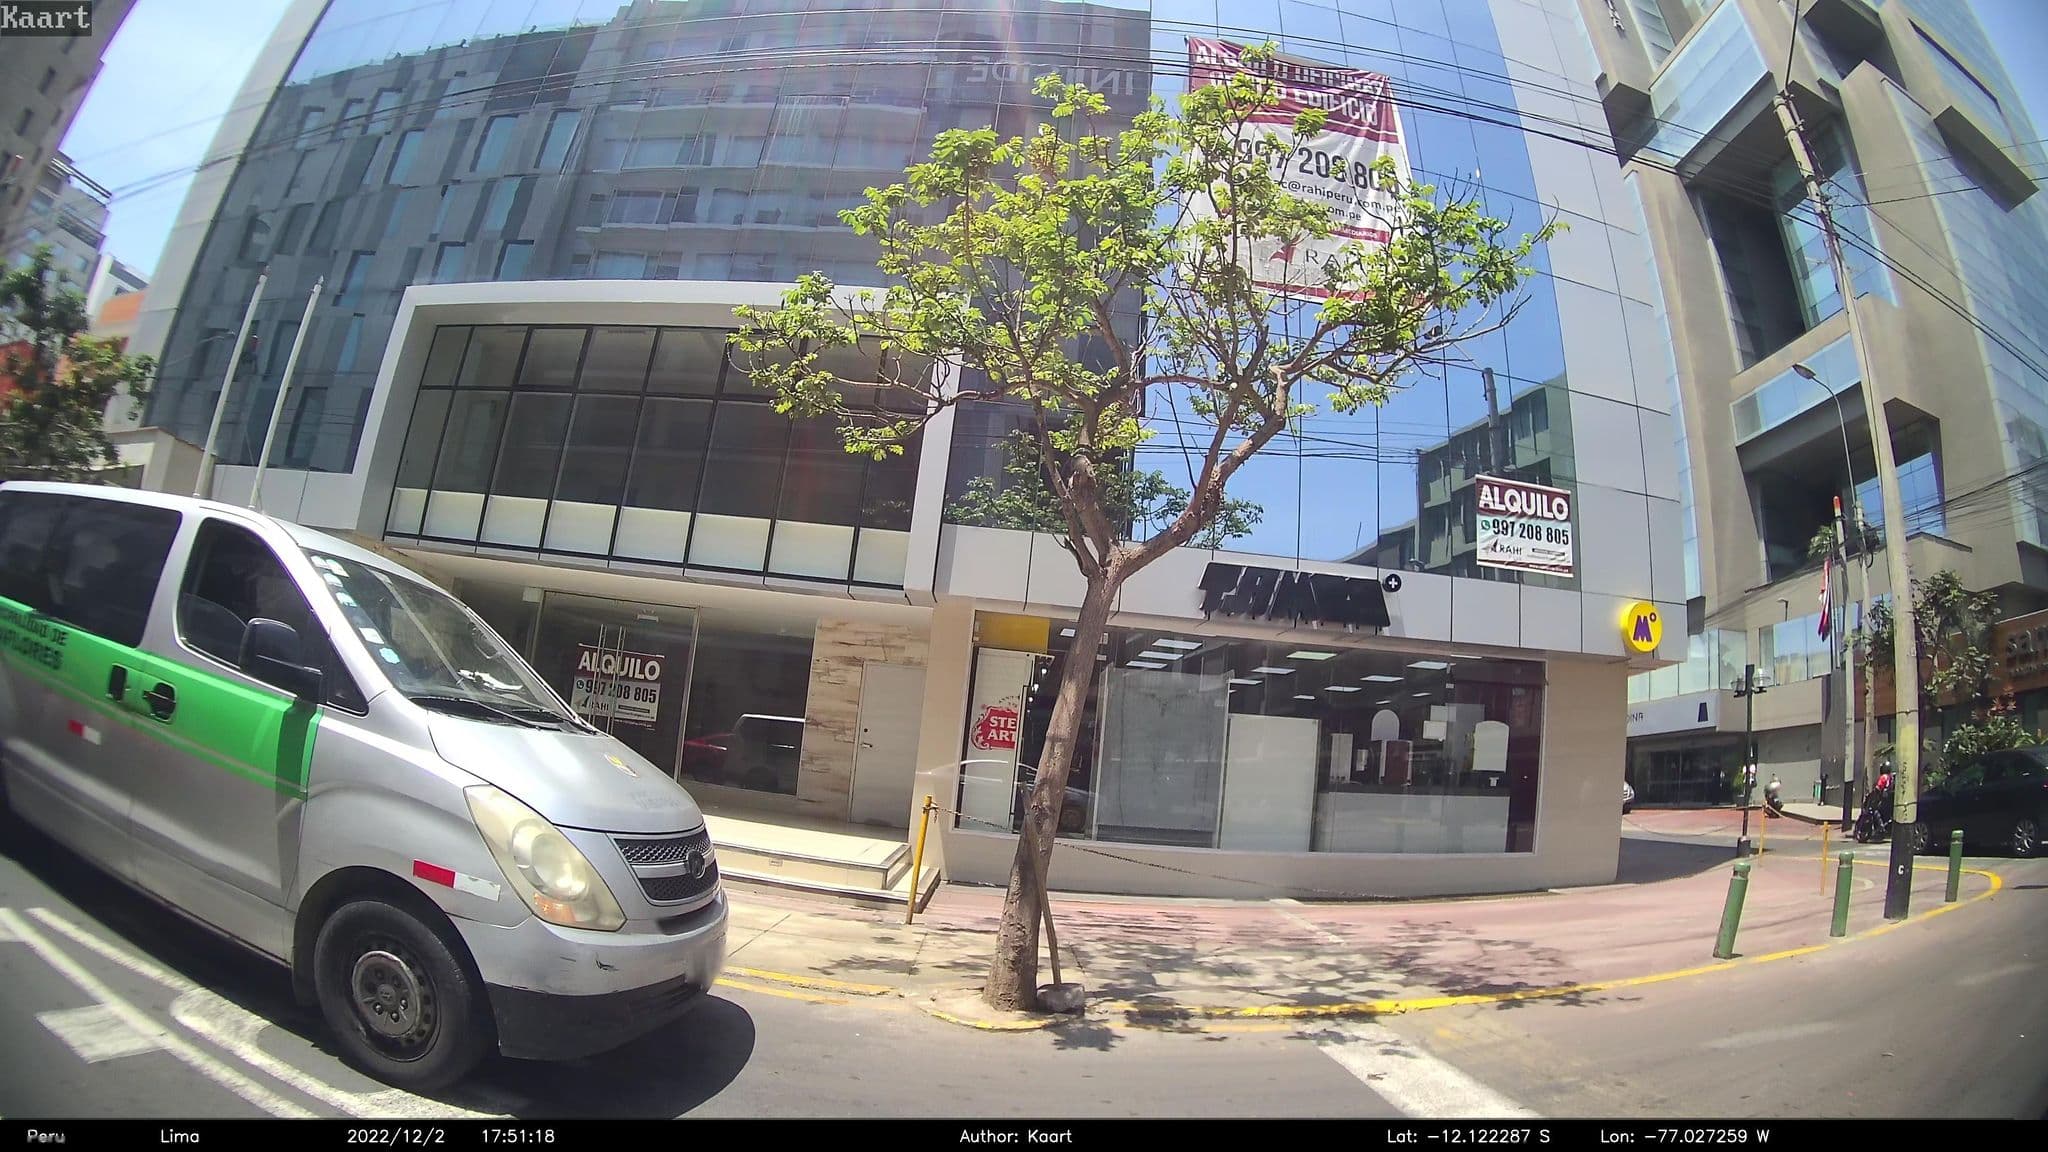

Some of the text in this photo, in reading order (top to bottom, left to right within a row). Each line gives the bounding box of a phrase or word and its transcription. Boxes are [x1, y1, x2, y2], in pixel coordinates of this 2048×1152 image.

[1479, 484, 1569, 521] ALQUILO
[1492, 518, 1569, 545] 997 208 805
[578, 651, 661, 681] ALQUILO
[633, 686, 657, 704] 805
[989, 716, 1017, 729] STE
